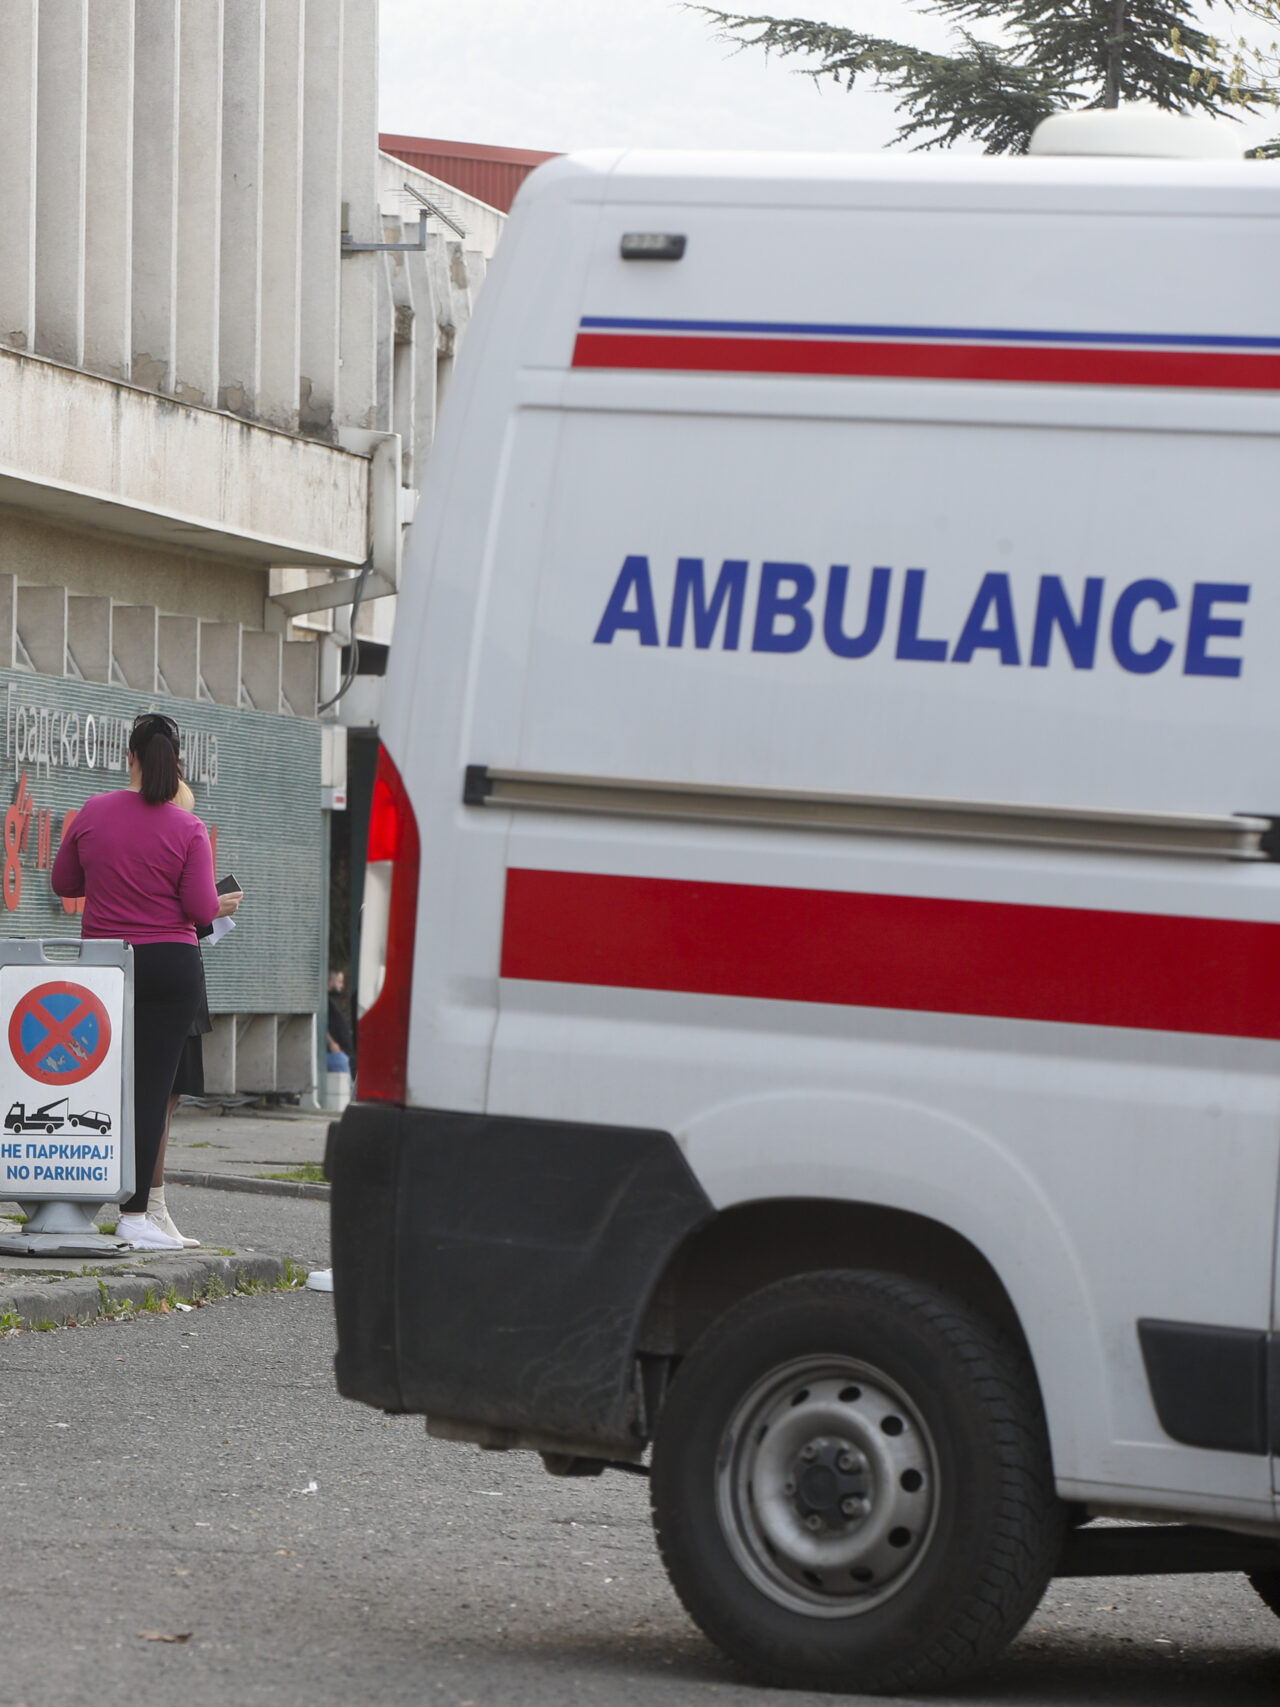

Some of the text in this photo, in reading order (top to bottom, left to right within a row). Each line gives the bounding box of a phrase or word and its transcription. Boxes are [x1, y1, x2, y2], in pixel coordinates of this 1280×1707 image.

[592, 554, 1251, 678] AMBULANCE
[6, 682, 80, 782] Градска
[85, 713, 132, 774] општ
[1, 1143, 114, 1160] НЕ ПАРКИРАЈ!
[6, 1165, 108, 1181] NO PARKING!
